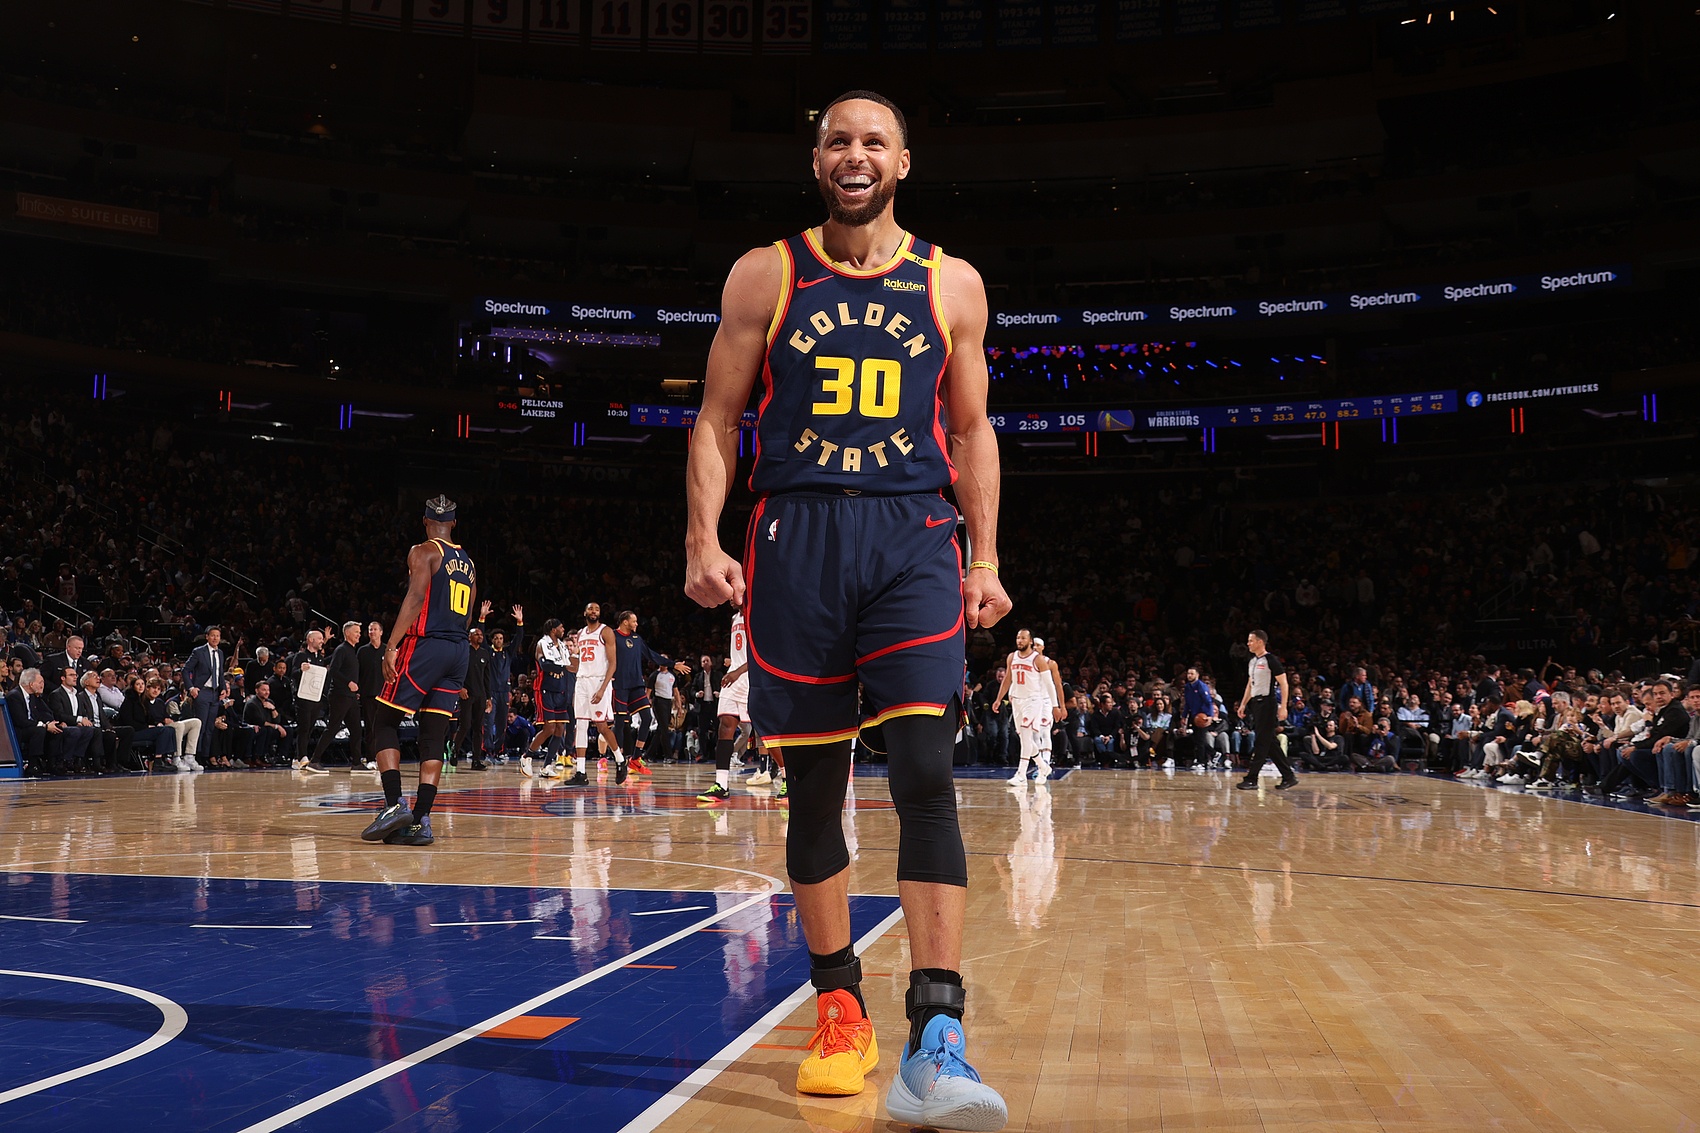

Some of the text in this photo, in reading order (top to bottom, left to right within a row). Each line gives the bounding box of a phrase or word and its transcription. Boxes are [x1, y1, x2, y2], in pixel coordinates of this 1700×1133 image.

[539, 0, 570, 28] 11
[940, 10, 982, 21] 1939-40
[998, 6, 1041, 18] 1993-94
[1054, 4, 1096, 15] 1926-27
[601, 1, 631, 35] 11
[655, 3, 692, 36] 19
[708, 5, 748, 38] 30
[766, 5, 809, 38] 35
[826, 12, 868, 22] 1927-28
[884, 12, 927, 22] 1932-33
[829, 24, 863, 32] STANLEY
[888, 24, 922, 32] STANLEY
[943, 23, 977, 32] STANLEY
[1002, 20, 1036, 29] STANLEY
[1058, 26, 1092, 35] DIVISION
[1174, 22, 1222, 33] CHAMPIONS
[838, 33, 853, 41] CUP
[897, 33, 913, 41] CUP
[952, 32, 968, 40] CUP
[1011, 29, 1027, 37] CUP
[1051, 34, 1098, 44] CHAMPIONS
[1116, 28, 1162, 40] CHAMPIONS
[937, 40, 983, 49] CHAMPIONS
[996, 37, 1042, 46] CHAMPIONS
[21, 197, 154, 229] Infosys SUITE LEVEL
[883, 278, 926, 291] Rakuten
[1540, 271, 1612, 291] Spectrum
[1444, 282, 1512, 302] Spectrum
[1349, 291, 1417, 309] Spectrum
[485, 299, 546, 315] Spectrum
[571, 305, 632, 320] Spectrum
[1169, 305, 1233, 321] Spectrum
[1258, 299, 1324, 316] Spectrum
[656, 309, 717, 324] Spectrum
[996, 312, 1057, 327] Spectrum
[1082, 310, 1144, 325] Spectrum
[788, 302, 932, 358] GOLDEN
[811, 355, 902, 418] 30
[1487, 383, 1599, 402] FACEBOOK.COM/NYKNICKS
[498, 401, 518, 411] 9:46
[521, 398, 564, 409] PELICANS
[520, 408, 556, 418] LAKERS
[606, 409, 628, 417] 10:30
[1253, 415, 1260, 423] 3
[1272, 413, 1294, 421] 33.3
[1304, 411, 1327, 419] 47.0
[1373, 407, 1384, 415] 11
[1393, 406, 1400, 414] 5
[1411, 404, 1423, 412] 26
[1430, 402, 1442, 410] 42
[640, 416, 646, 424] 5
[988, 416, 1006, 427] 93
[1019, 420, 1048, 430] 2:39
[1059, 415, 1086, 426] 105
[1148, 415, 1200, 427] WARRIORS
[794, 427, 914, 472] STATE
[445, 558, 469, 576] BUTLER
[449, 578, 471, 616] 10
[735, 632, 743, 651] 8
[1516, 638, 1557, 650] ULTRA
[581, 646, 595, 662] 25
[1017, 671, 1025, 684] 11
